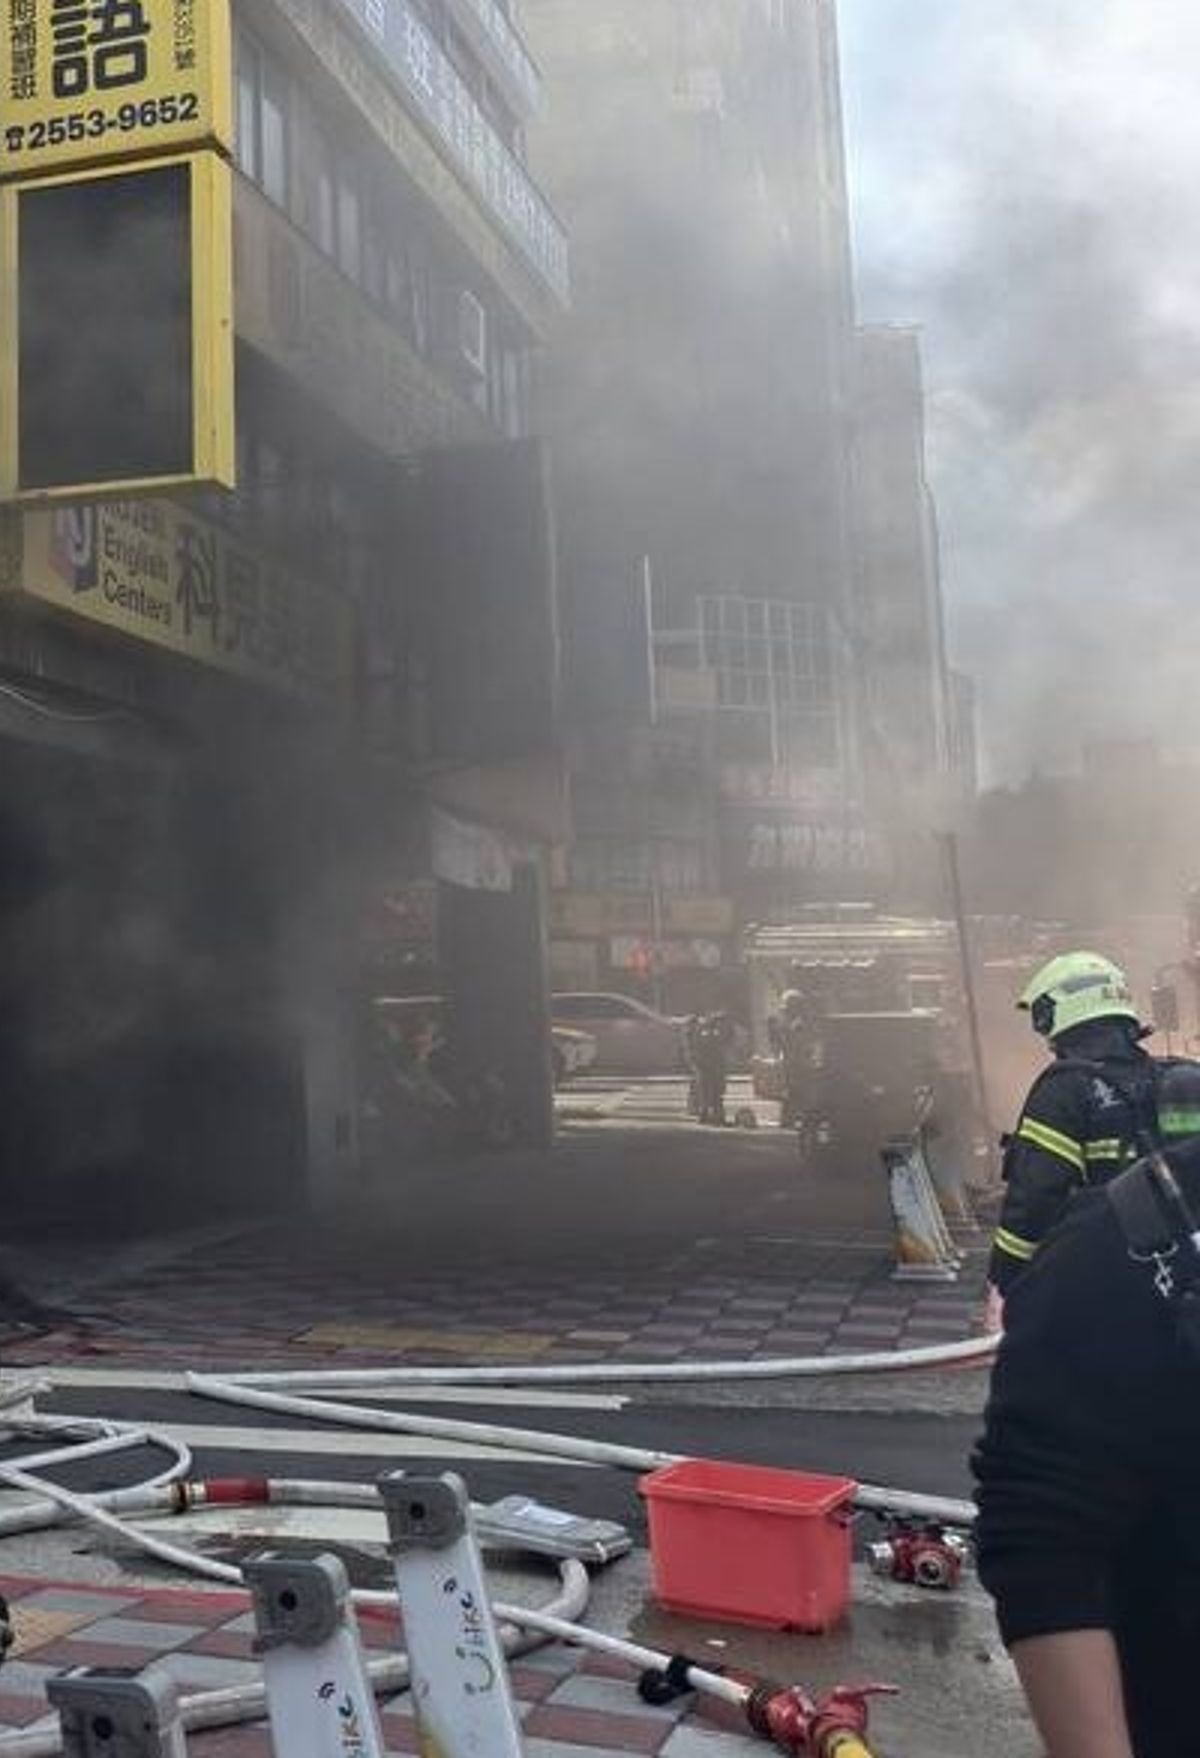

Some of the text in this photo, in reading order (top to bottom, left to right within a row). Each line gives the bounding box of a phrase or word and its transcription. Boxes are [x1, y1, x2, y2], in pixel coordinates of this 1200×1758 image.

[29, 93, 199, 149] 2553-9652
[104, 523, 168, 584] English
[104, 568, 171, 627] Centers
